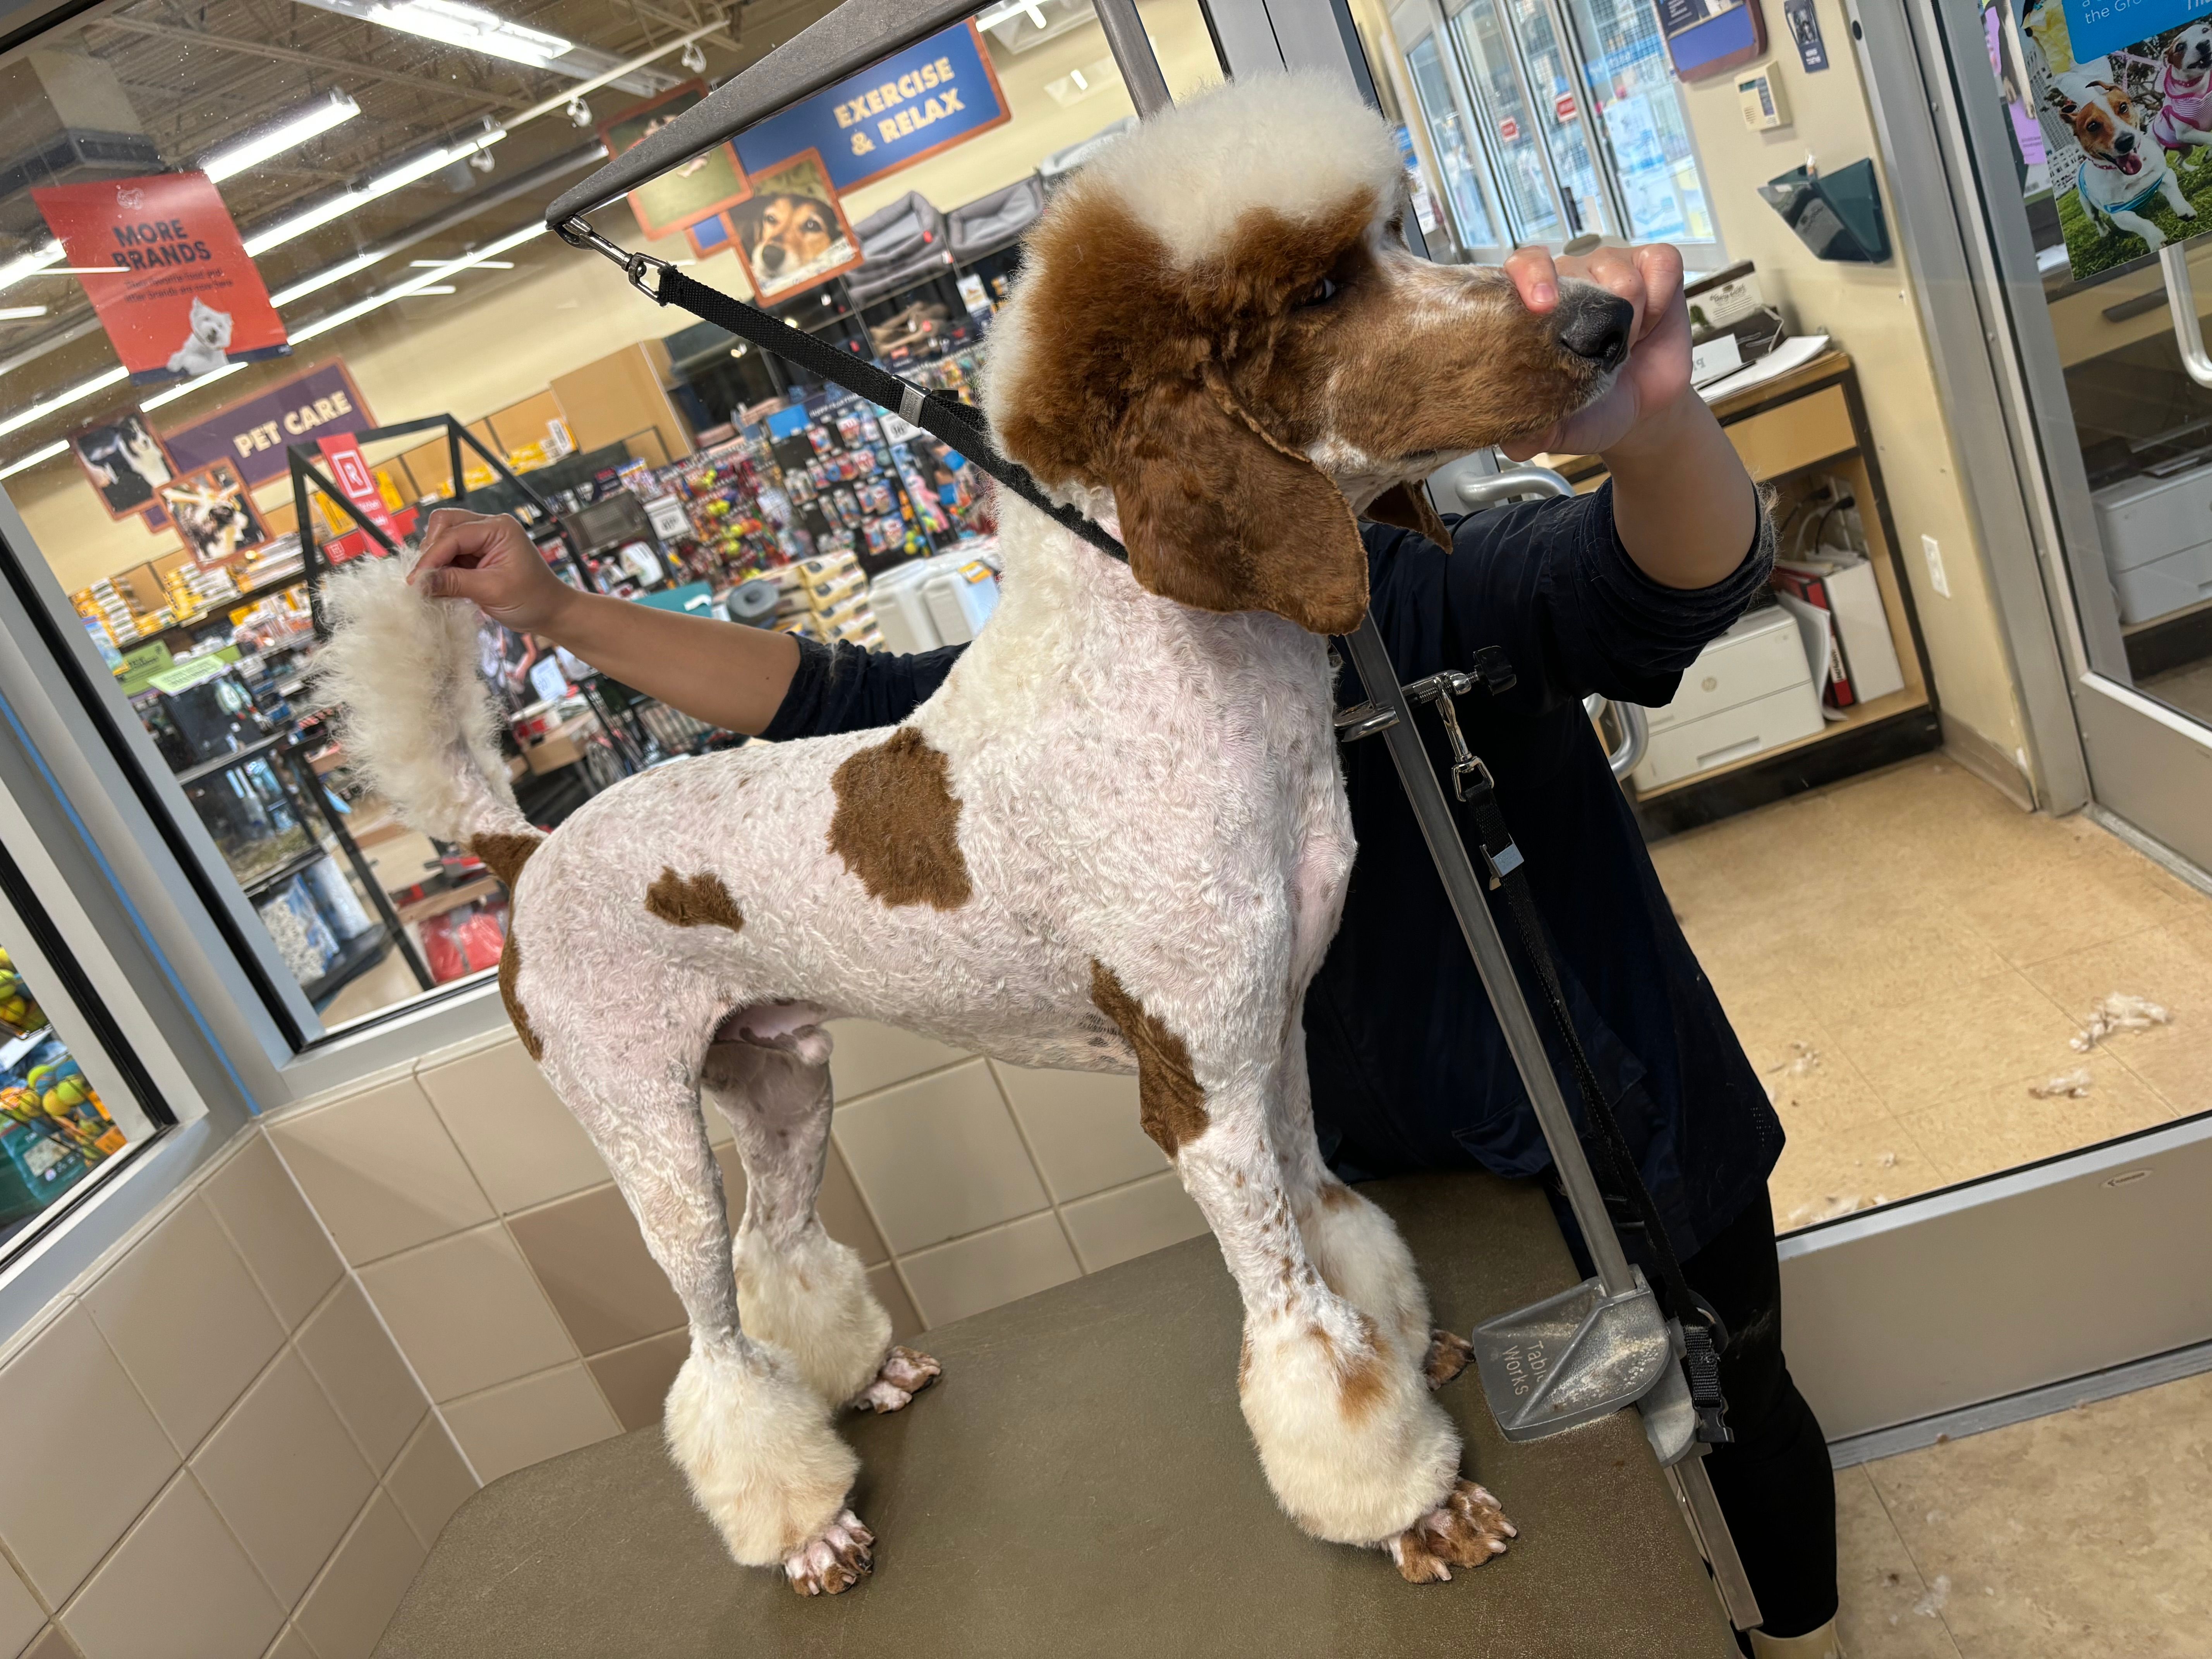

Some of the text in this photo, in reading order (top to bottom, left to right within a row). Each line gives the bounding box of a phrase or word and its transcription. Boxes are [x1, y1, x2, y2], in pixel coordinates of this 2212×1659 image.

[2085, 8, 2109, 24] the
[833, 57, 955, 129] EXERCISE
[850, 88, 966, 156] & RELAX
[112, 242, 211, 270] BRANDS
[113, 220, 188, 247] MORE
[233, 390, 352, 458] PET CARE
[1502, 1345, 1529, 1395] Works
